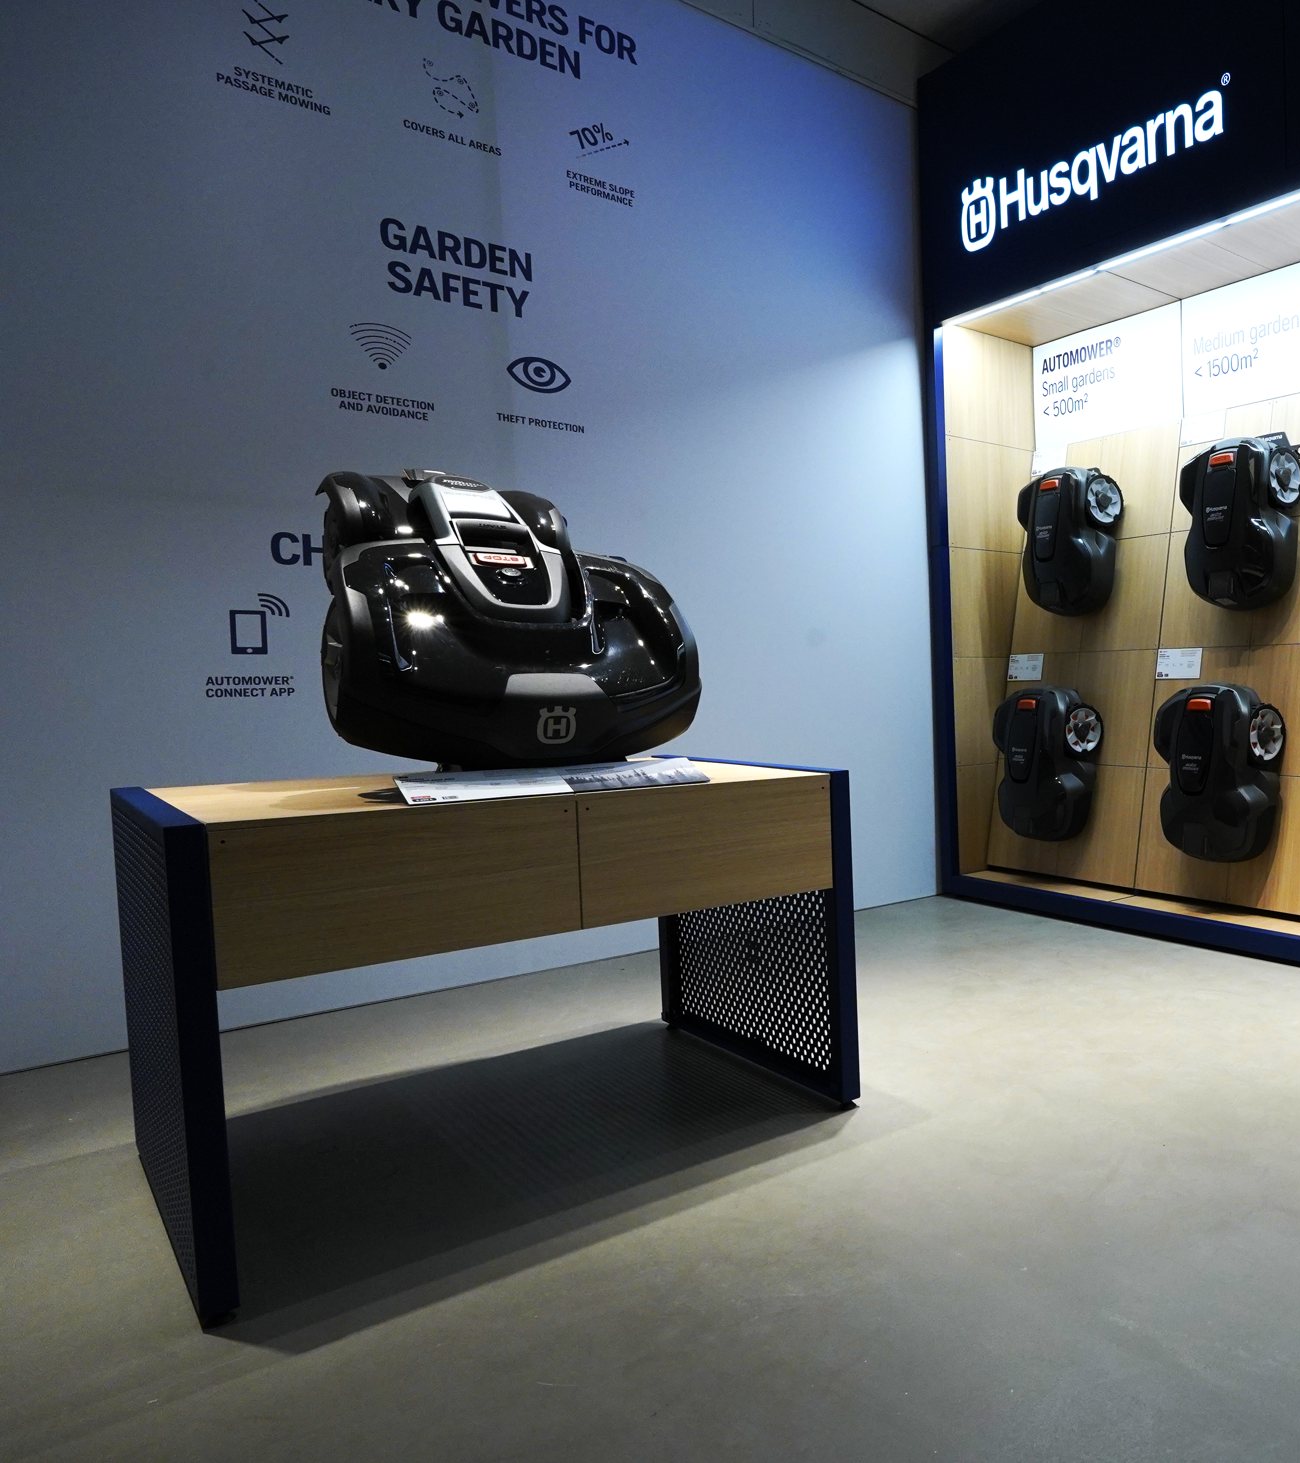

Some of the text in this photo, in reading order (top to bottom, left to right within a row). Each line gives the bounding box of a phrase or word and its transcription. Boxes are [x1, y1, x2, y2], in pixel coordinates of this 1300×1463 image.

[437, 0, 581, 79] GARDEN
[578, 15, 638, 65] FOR
[216, 72, 331, 116] PASSAGE MOWING
[234, 66, 313, 99] SYSTEMATIC
[403, 119, 502, 156] COVERS ALL AREAS
[569, 122, 614, 149] 70%
[566, 169, 635, 199] EXTREME SLOPE
[569, 180, 633, 207] PERFORMANCE
[380, 217, 533, 282] GARDEN
[387, 260, 530, 318] SAFETY
[1193, 330, 1245, 356] Medium
[1042, 366, 1115, 397] Small gardens
[330, 387, 434, 411] OBJECT DETECTION
[338, 399, 428, 421] AND AVOIDANCE
[496, 412, 585, 434] THEFT PROTECTION
[206, 687, 295, 698] CONNECT APP
